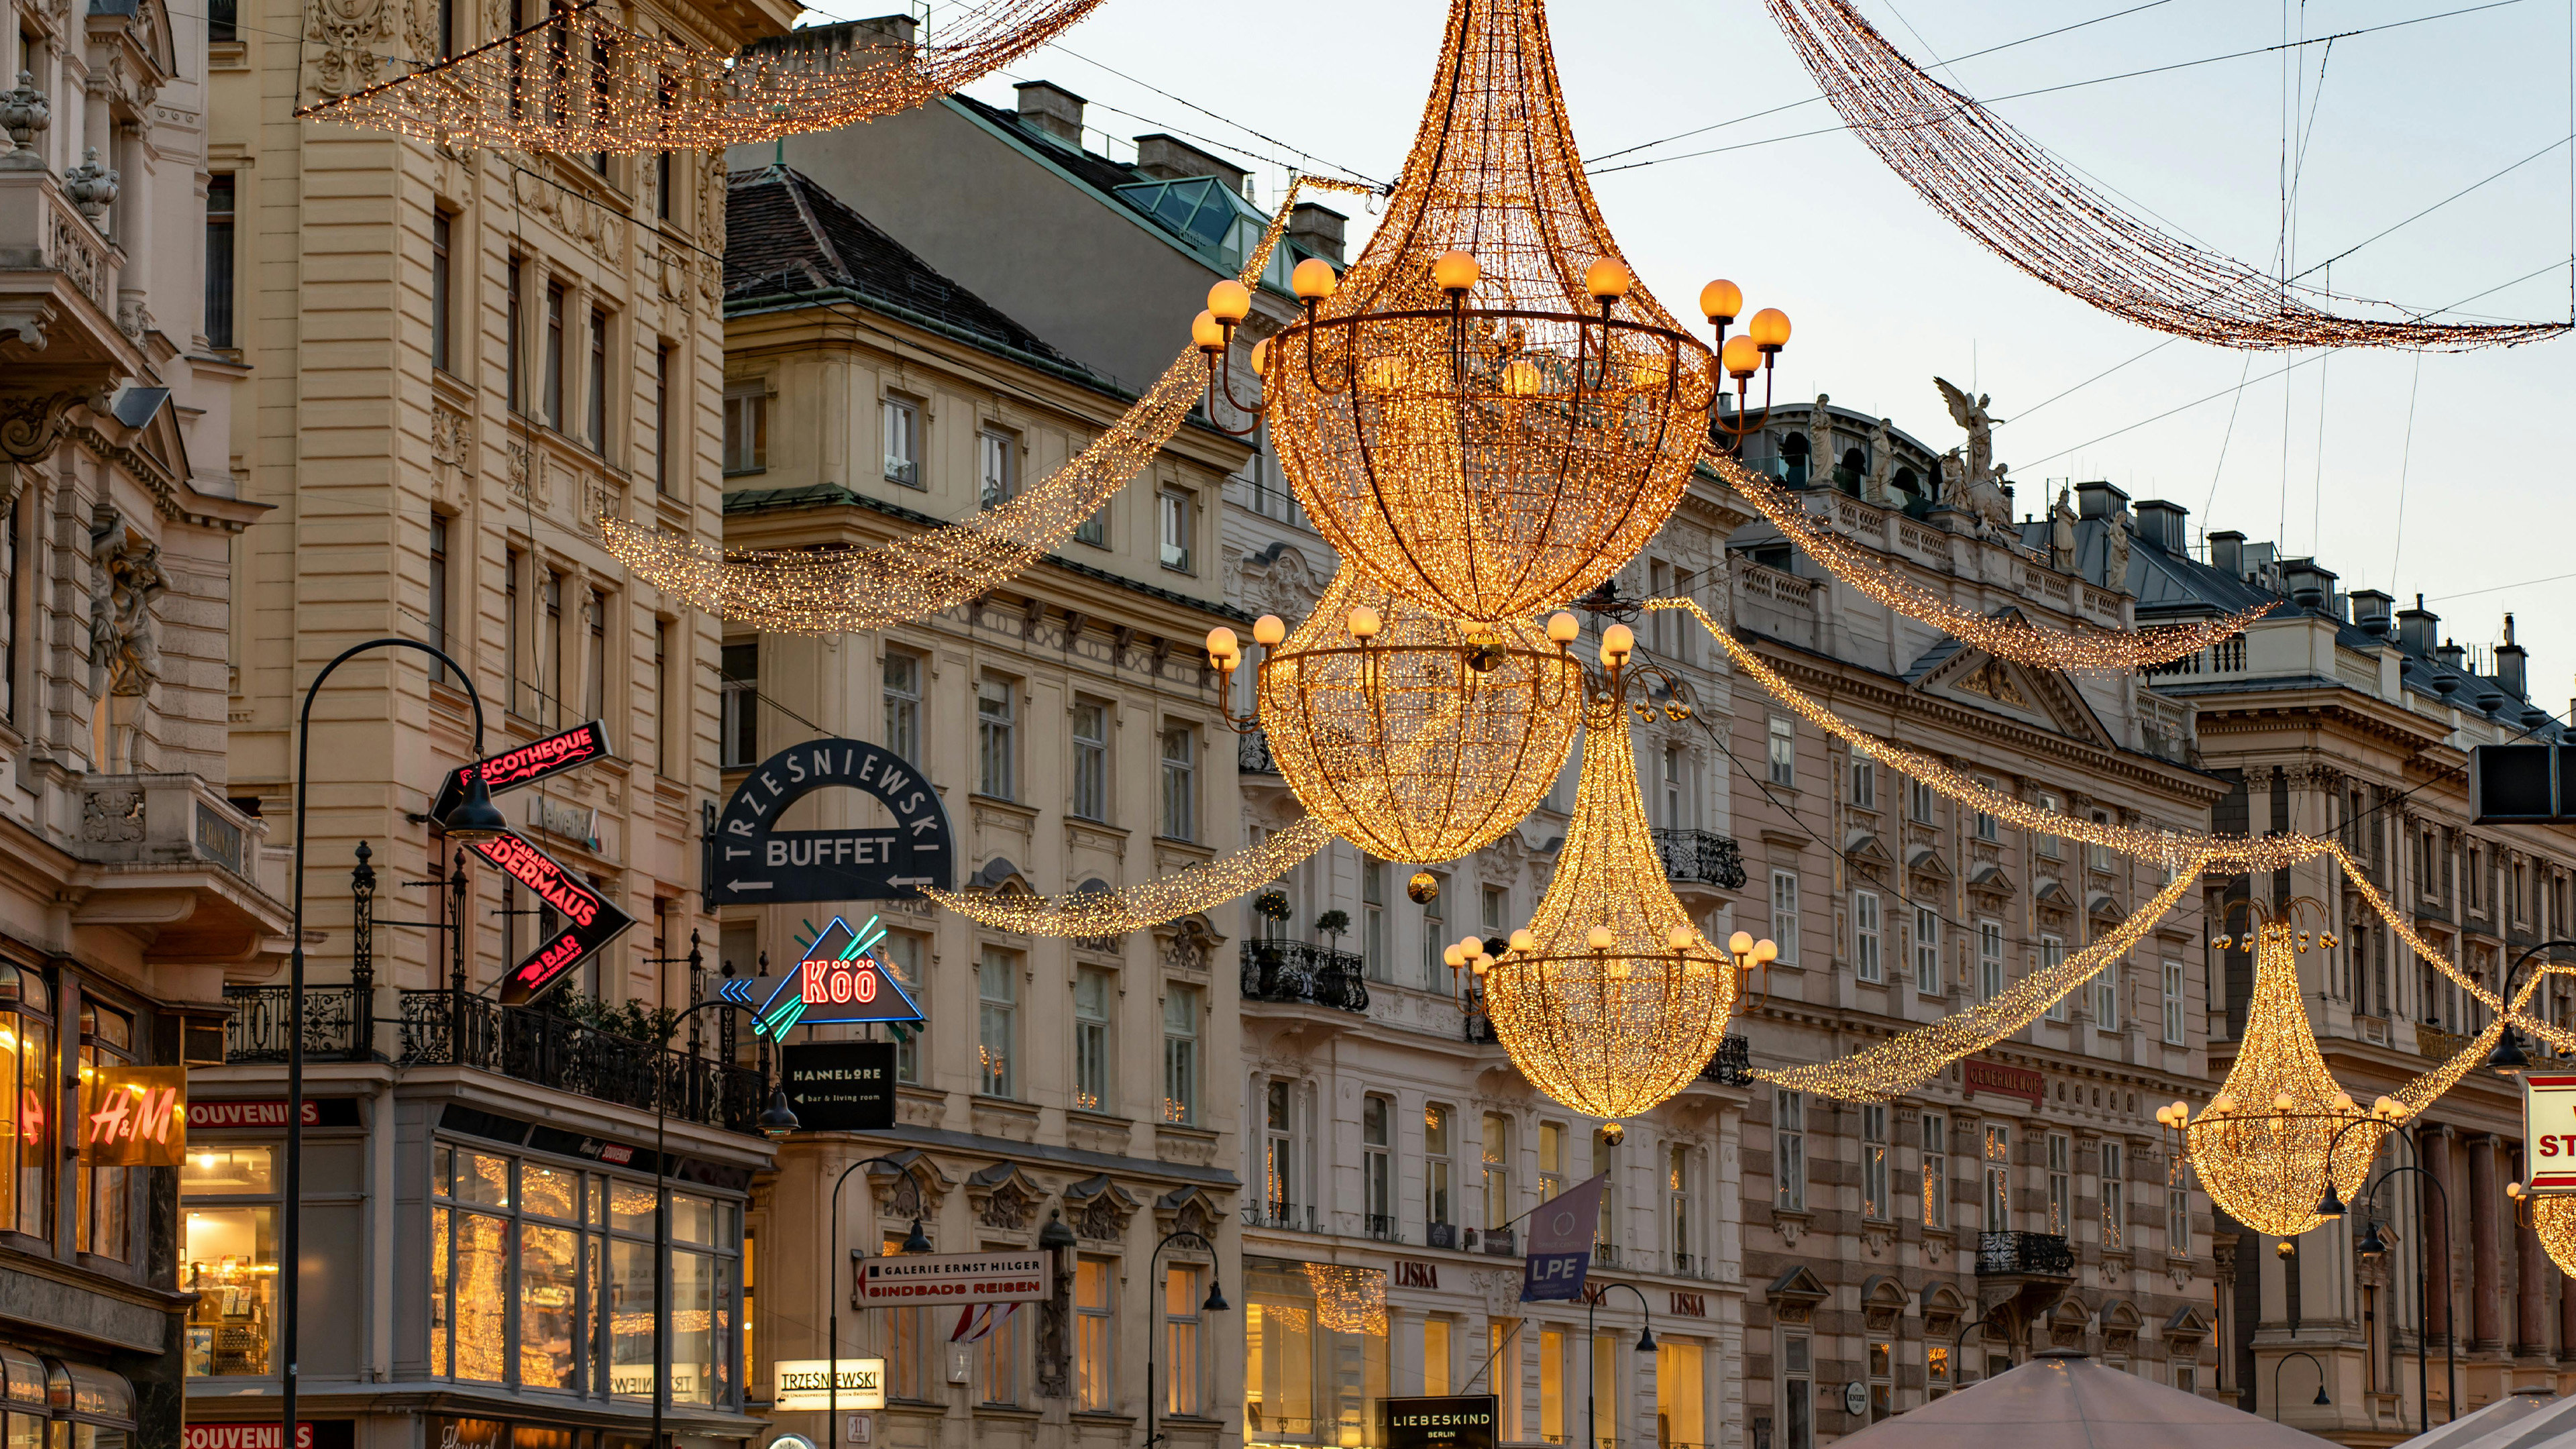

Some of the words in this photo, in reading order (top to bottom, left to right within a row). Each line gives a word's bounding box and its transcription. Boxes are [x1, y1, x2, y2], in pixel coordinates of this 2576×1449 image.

[511, 838, 560, 877] CABARET
[766, 837, 896, 866] BUFFET
[541, 935, 579, 969] BAR
[794, 1069, 881, 1081] HANNELORE
[833, 1094, 857, 1103] living
[90, 1087, 176, 1144] H&M
[187, 1104, 317, 1124] OUVENIS
[885, 1265, 940, 1275] GALERIE
[945, 1263, 986, 1273] ERNST
[991, 1261, 1040, 1271] HILGER
[1395, 1261, 1439, 1289] LISKA
[1532, 1258, 1578, 1281] LPE
[869, 1284, 967, 1297] SINDBADS
[973, 1281, 1040, 1293] REISEN
[1670, 1292, 1706, 1317] LISKA
[782, 1371, 877, 1390] TRZEŚNEWSKI
[854, 1417, 863, 1434] 11
[1393, 1413, 1490, 1427] LIEBESKIND
[184, 1427, 311, 1449] OUVENIS
